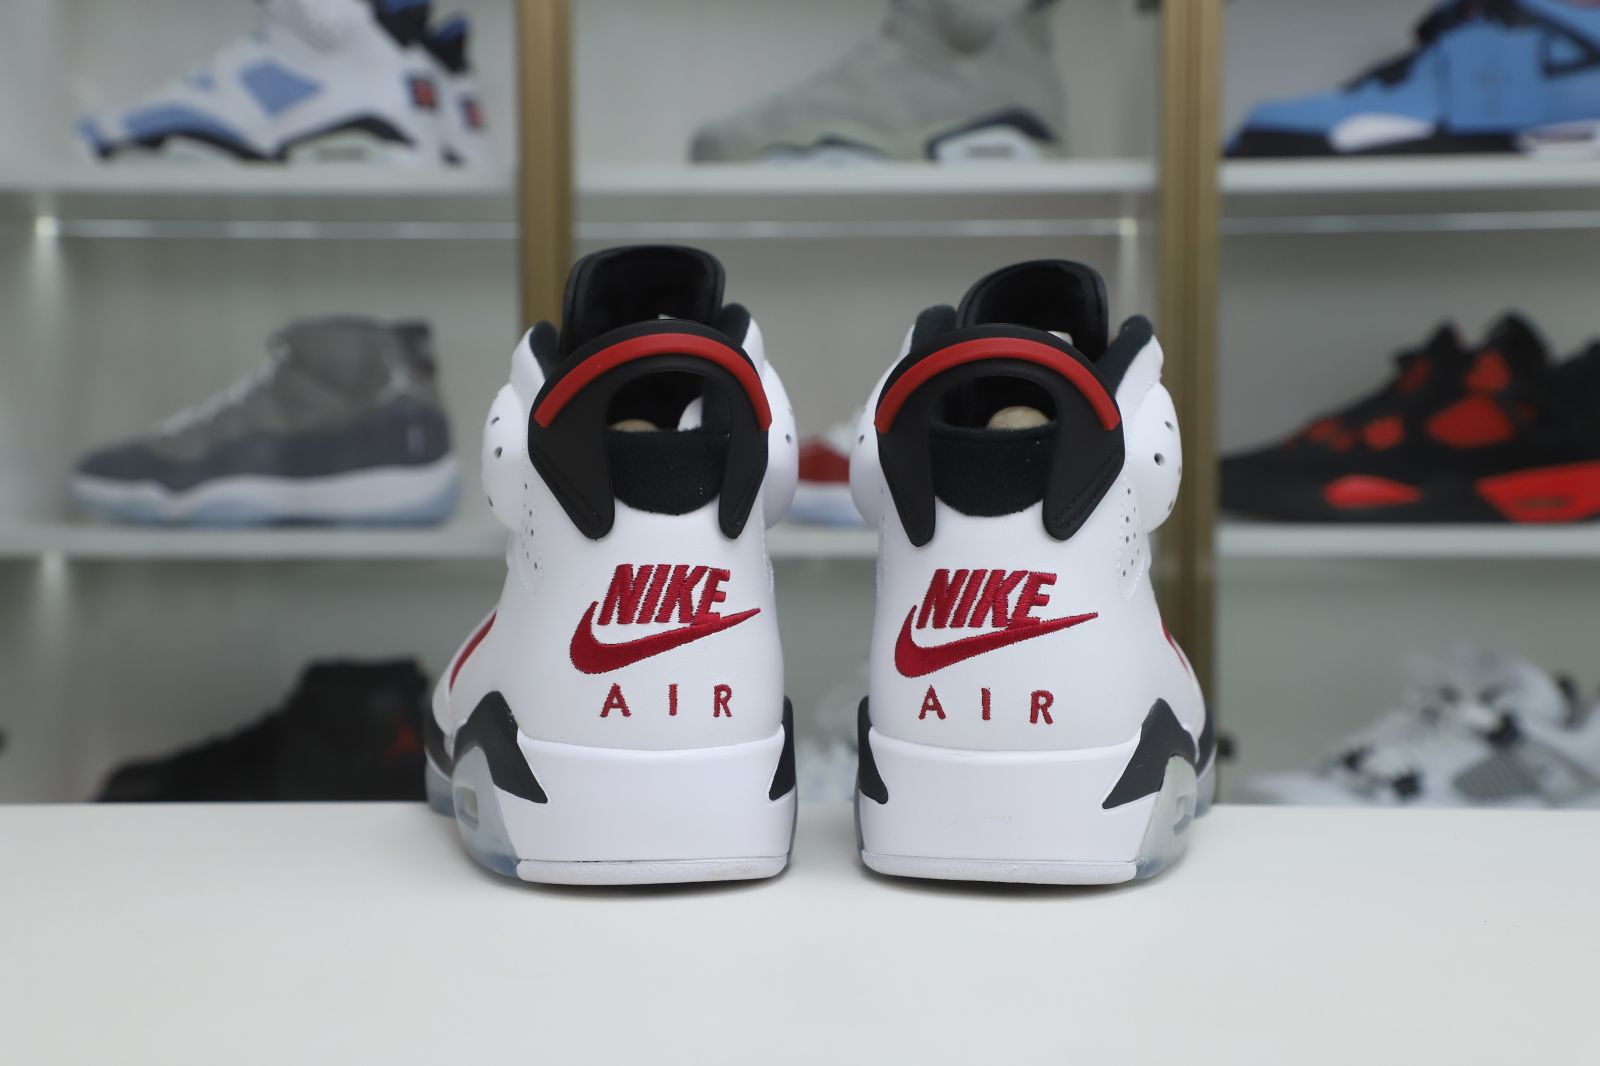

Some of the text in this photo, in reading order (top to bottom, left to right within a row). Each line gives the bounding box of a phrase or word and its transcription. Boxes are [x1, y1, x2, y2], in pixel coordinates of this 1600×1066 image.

[597, 563, 731, 627] NIKE
[915, 568, 1057, 630] NIKE
[600, 683, 732, 717] AIR
[918, 685, 1054, 724] AIR
